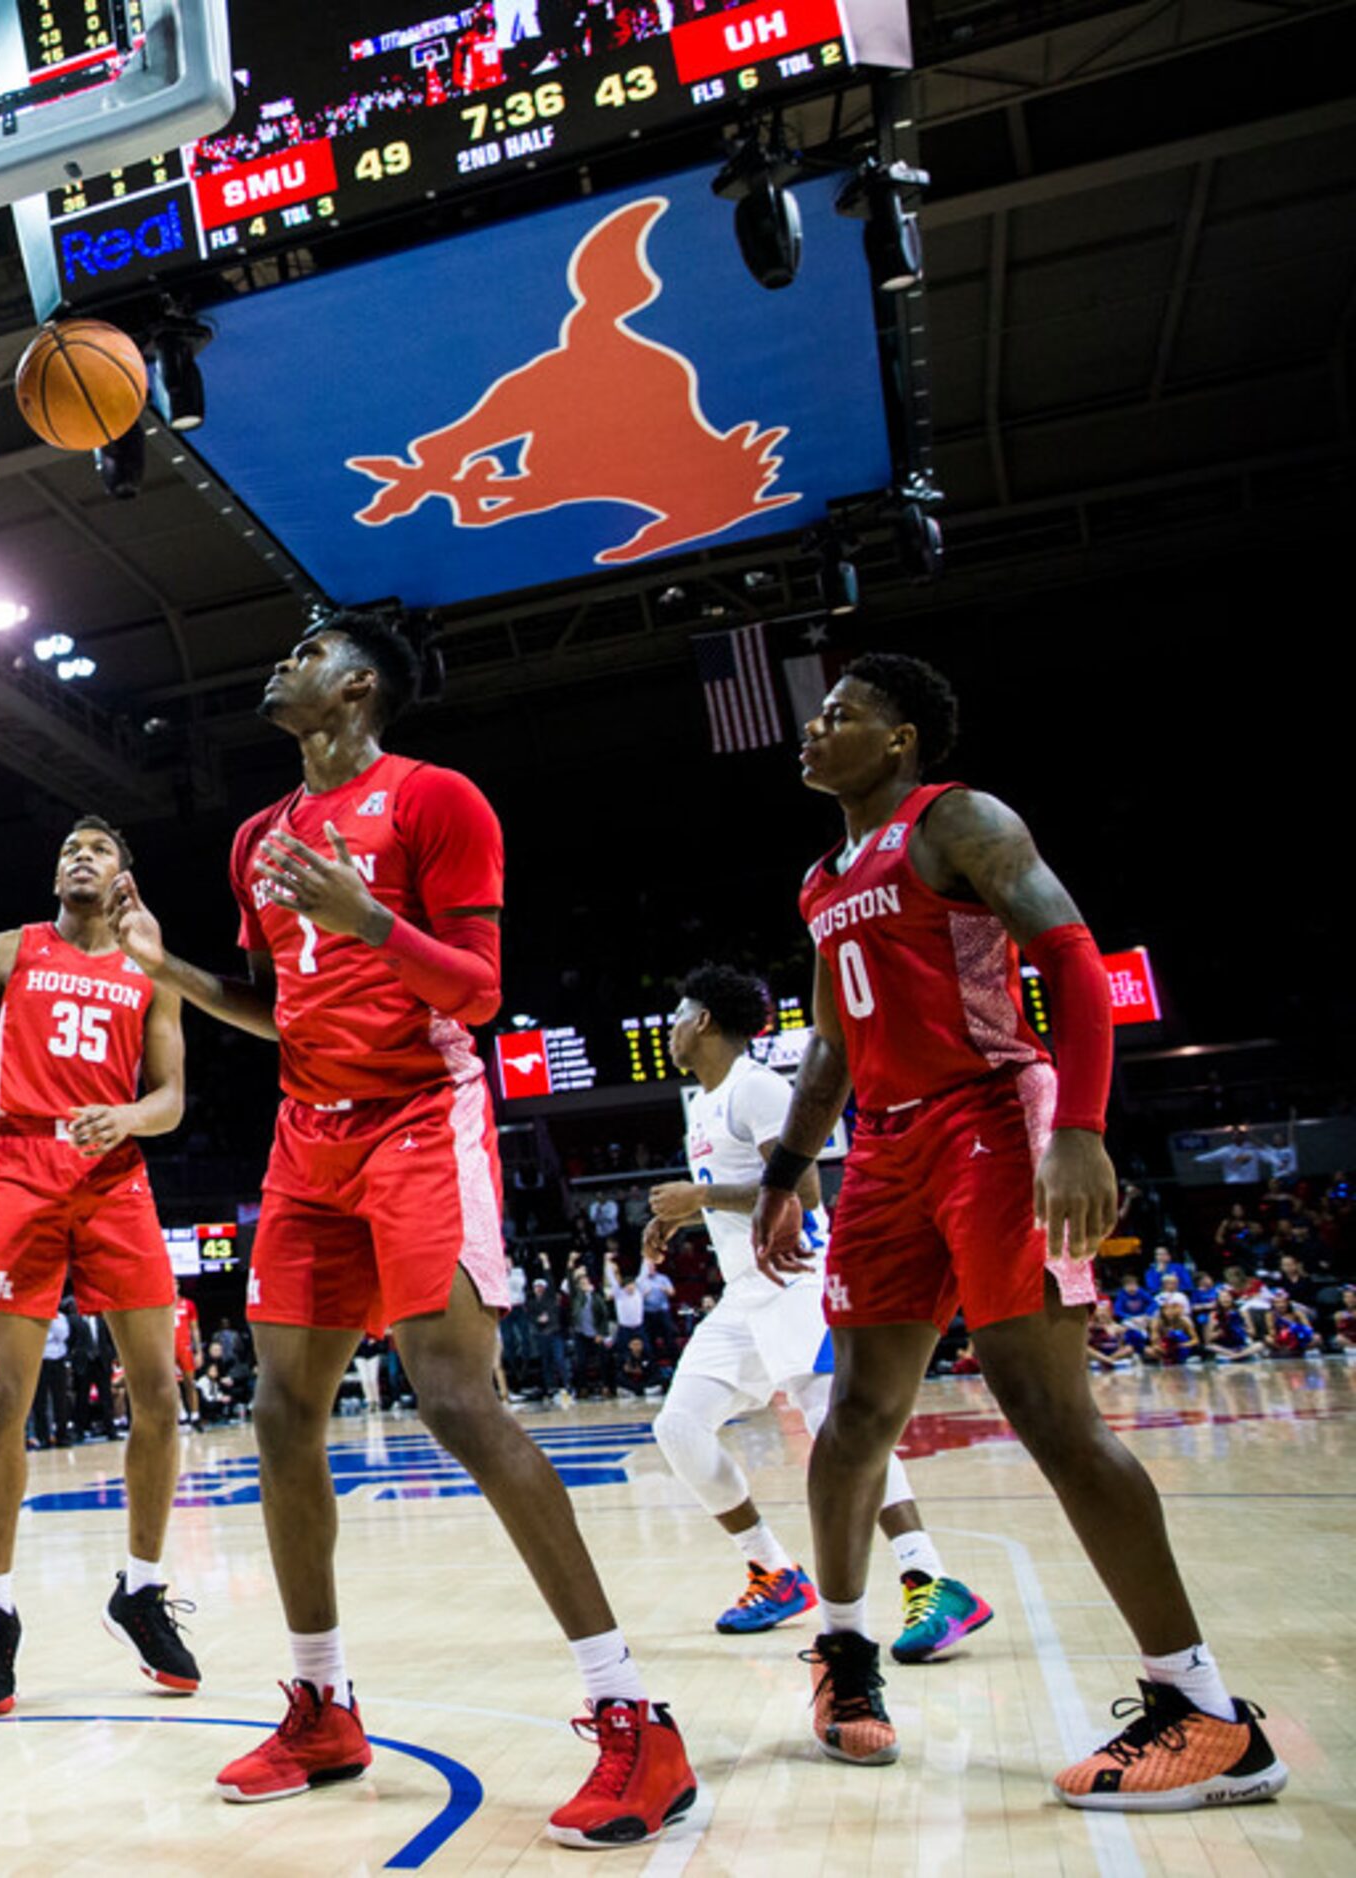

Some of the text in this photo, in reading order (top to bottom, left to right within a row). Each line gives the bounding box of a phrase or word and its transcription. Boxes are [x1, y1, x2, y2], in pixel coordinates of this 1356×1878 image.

[724, 9, 788, 52] UH
[595, 65, 658, 107] 43
[691, 41, 842, 105] FLS 6 TOL 2
[460, 82, 566, 141] 7:36
[355, 141, 412, 181] 49
[457, 125, 555, 174] 2ND HALF
[222, 160, 306, 207] SMU
[60, 200, 185, 283] Real
[210, 226, 239, 250] FLS
[248, 216, 267, 236] 4
[317, 196, 335, 217] 3
[808, 884, 902, 950] OUSTON
[26, 969, 141, 1010] HOUSTON
[839, 940, 875, 1020] 0
[47, 1000, 112, 1064] 35
[202, 1238, 232, 1259] 43
